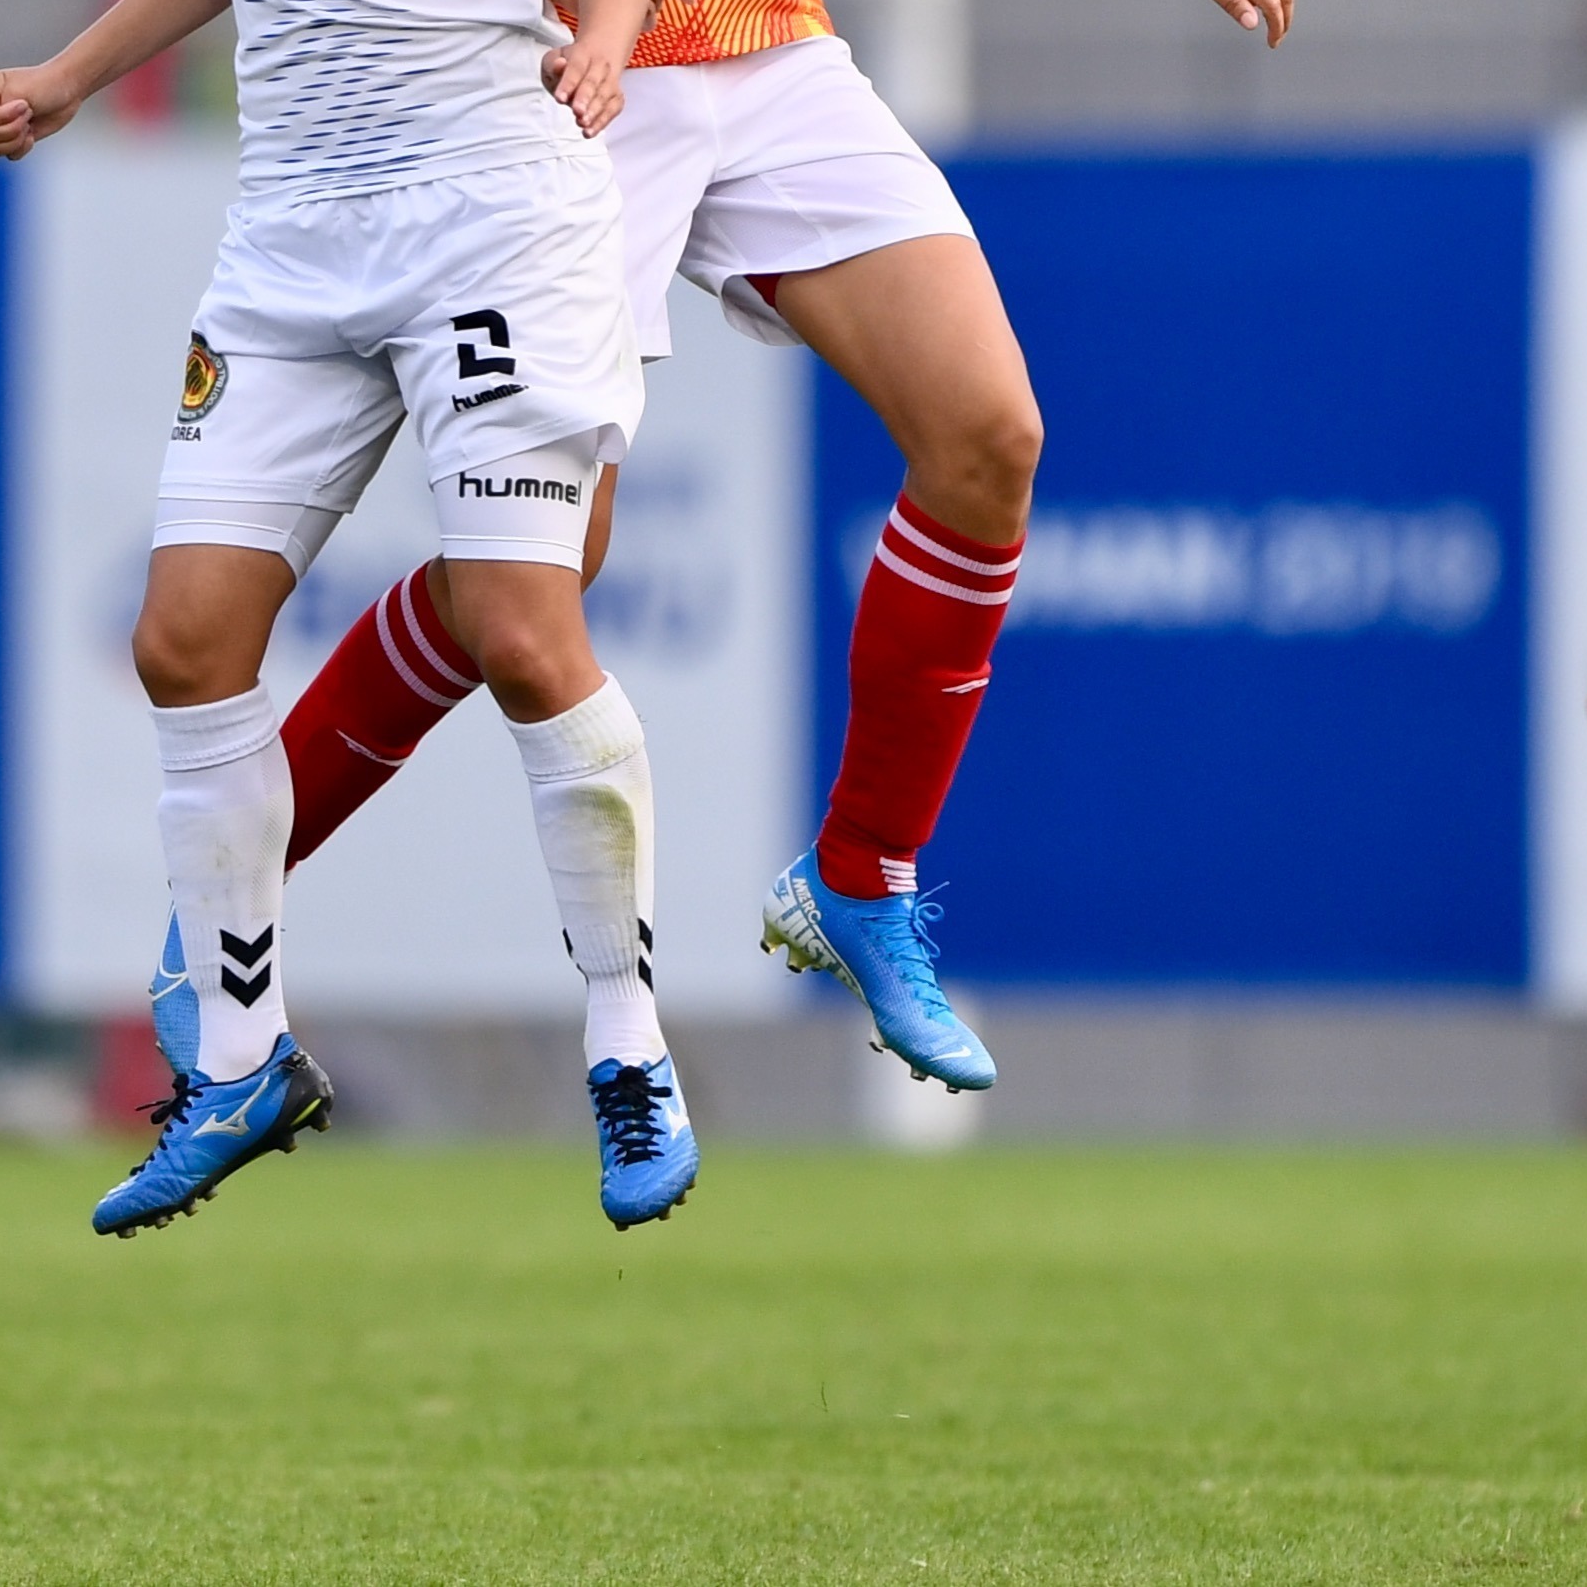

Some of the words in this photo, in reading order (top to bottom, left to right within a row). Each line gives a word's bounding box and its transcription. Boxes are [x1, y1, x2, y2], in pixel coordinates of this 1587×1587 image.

[449, 308, 517, 379] 2
[451, 383, 529, 412] humme
[171, 426, 202, 441] OREA
[459, 471, 582, 507] hummel
